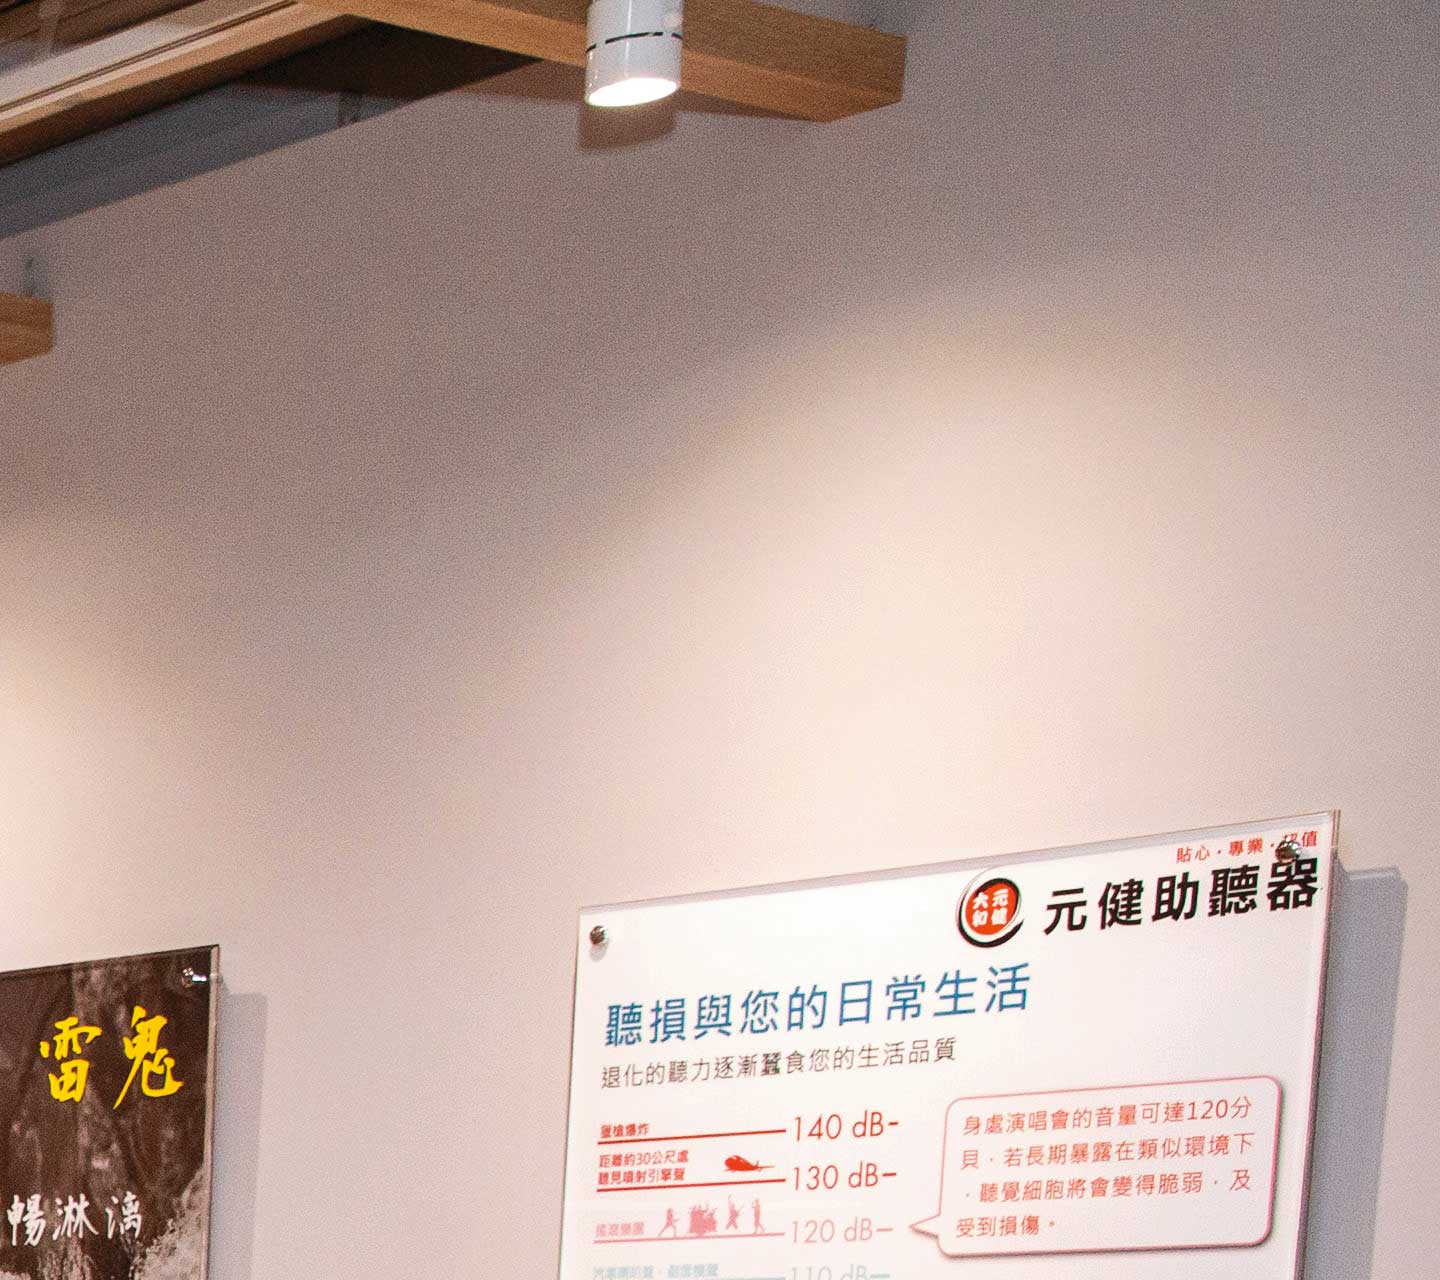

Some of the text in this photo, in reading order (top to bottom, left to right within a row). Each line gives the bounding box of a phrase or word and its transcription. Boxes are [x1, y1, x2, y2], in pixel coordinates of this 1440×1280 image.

[1042, 856, 1320, 936] 元健助聽器
[604, 961, 1032, 1048] 聽損與您的日常生活
[39, 1004, 185, 1110] 雷鬼
[600, 1036, 959, 1090] 退化的聽力逐漸蠶食您的生活品質
[793, 1110, 885, 1142] 140 dB
[962, 1094, 1253, 1138] 身處演唱會的音量可達120分
[792, 1161, 881, 1192] 130 dB
[790, 1215, 875, 1246] 120 dB
